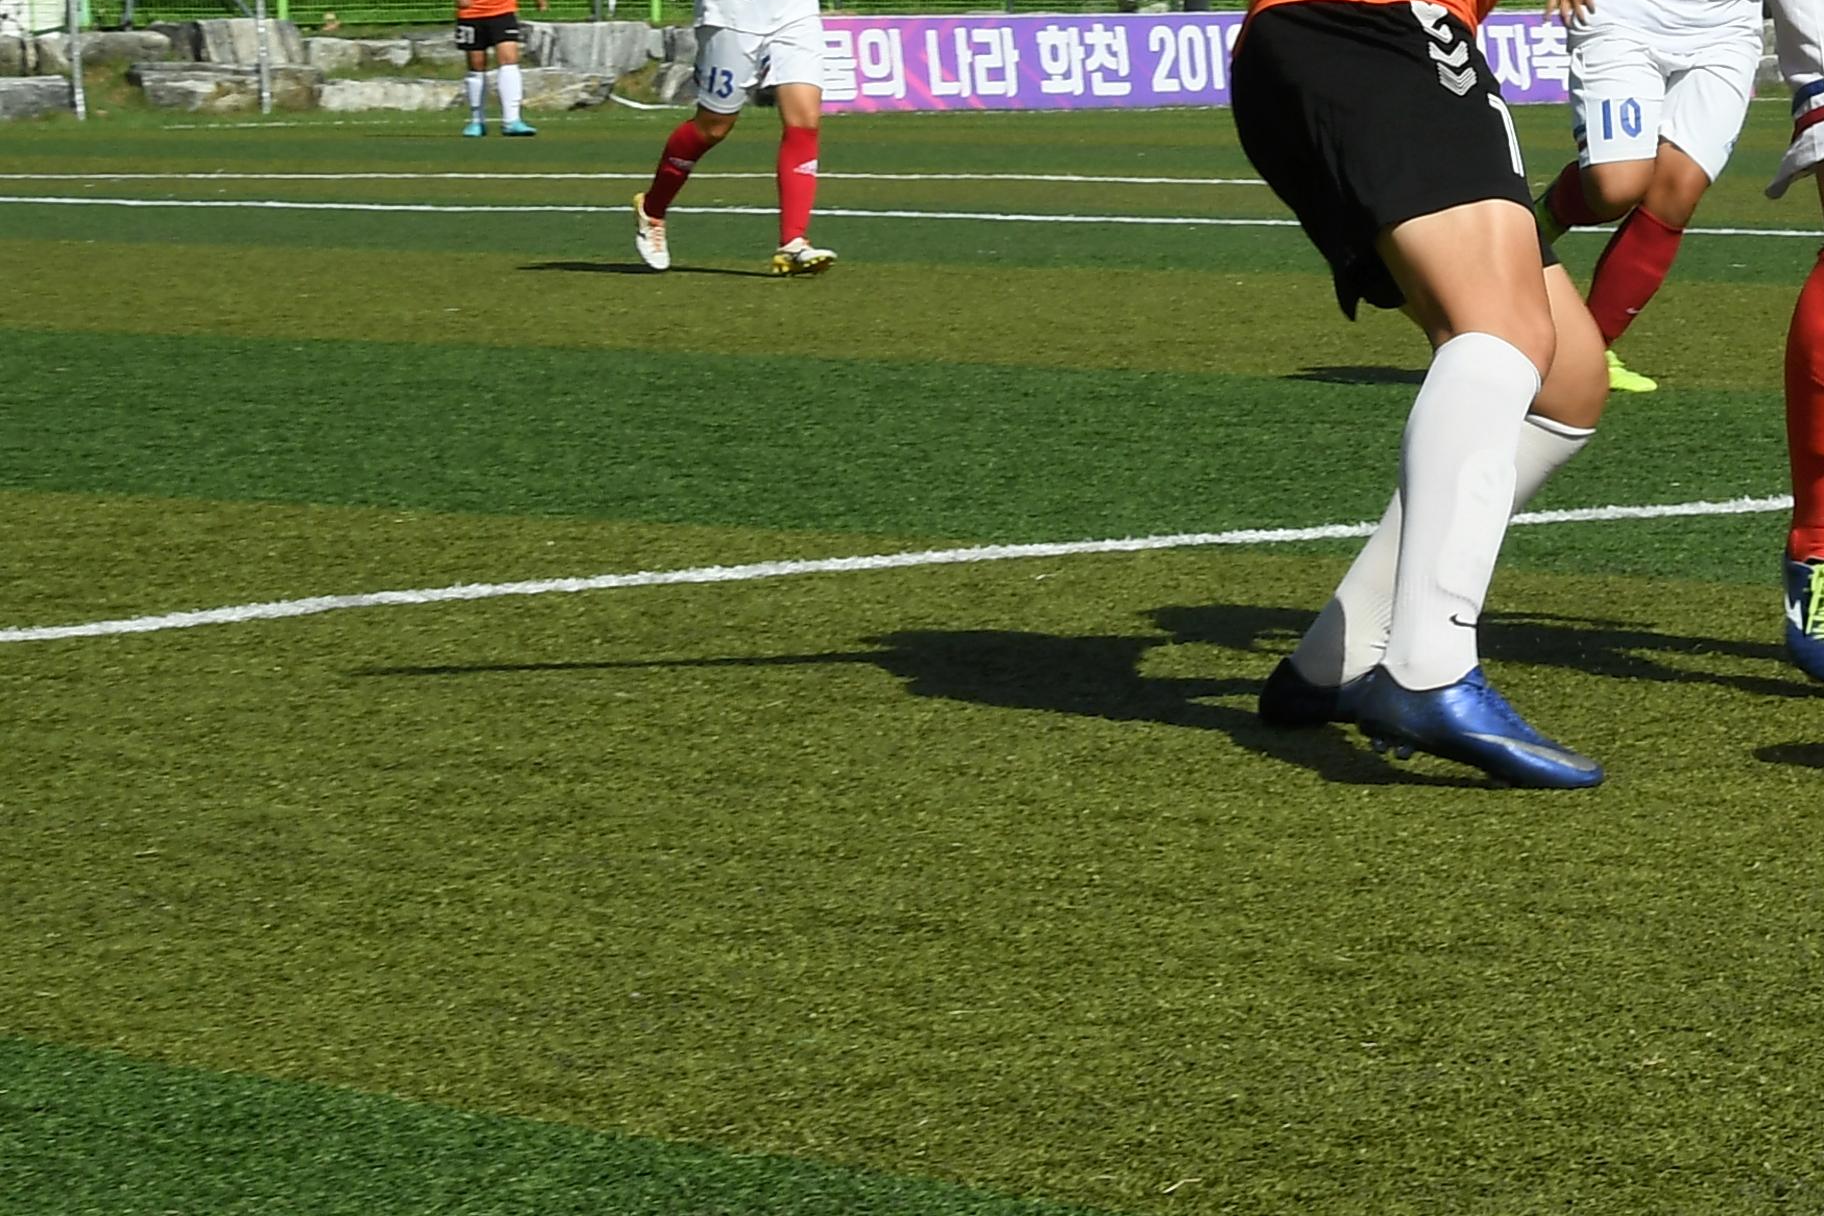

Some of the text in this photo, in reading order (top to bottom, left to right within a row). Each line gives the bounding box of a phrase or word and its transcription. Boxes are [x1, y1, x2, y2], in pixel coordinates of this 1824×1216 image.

[708, 66, 735, 100] 13
[926, 26, 1019, 99] 나라
[1036, 24, 1131, 98] 화천
[1601, 97, 1643, 141] 10
